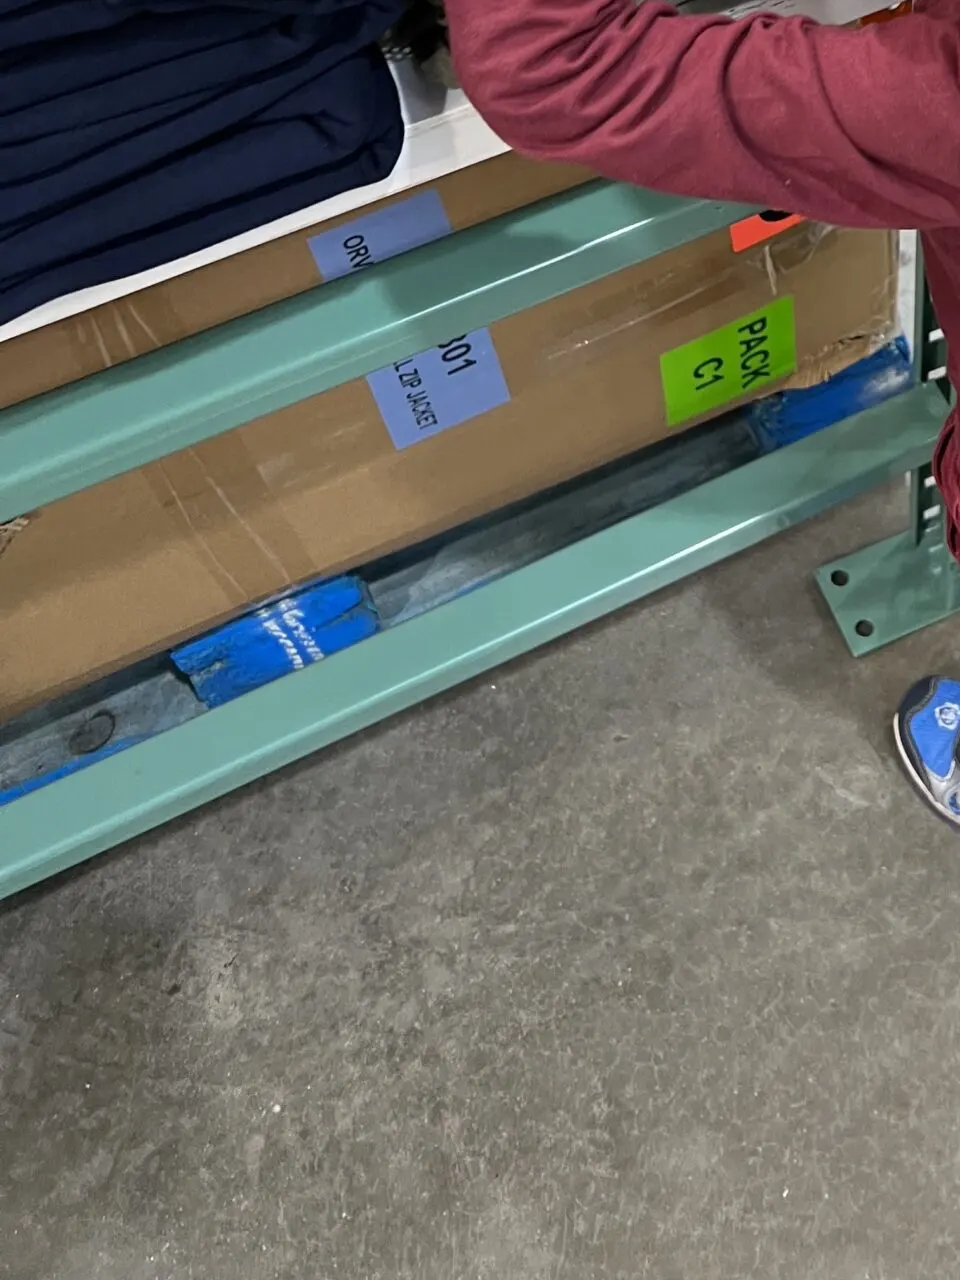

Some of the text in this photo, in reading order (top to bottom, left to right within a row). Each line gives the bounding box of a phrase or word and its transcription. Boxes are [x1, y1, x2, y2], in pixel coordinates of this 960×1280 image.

[738, 316, 771, 389] PACK
[398, 368, 422, 388] ZIP
[693, 357, 725, 392] C1
[406, 390, 438, 430] JACKET
